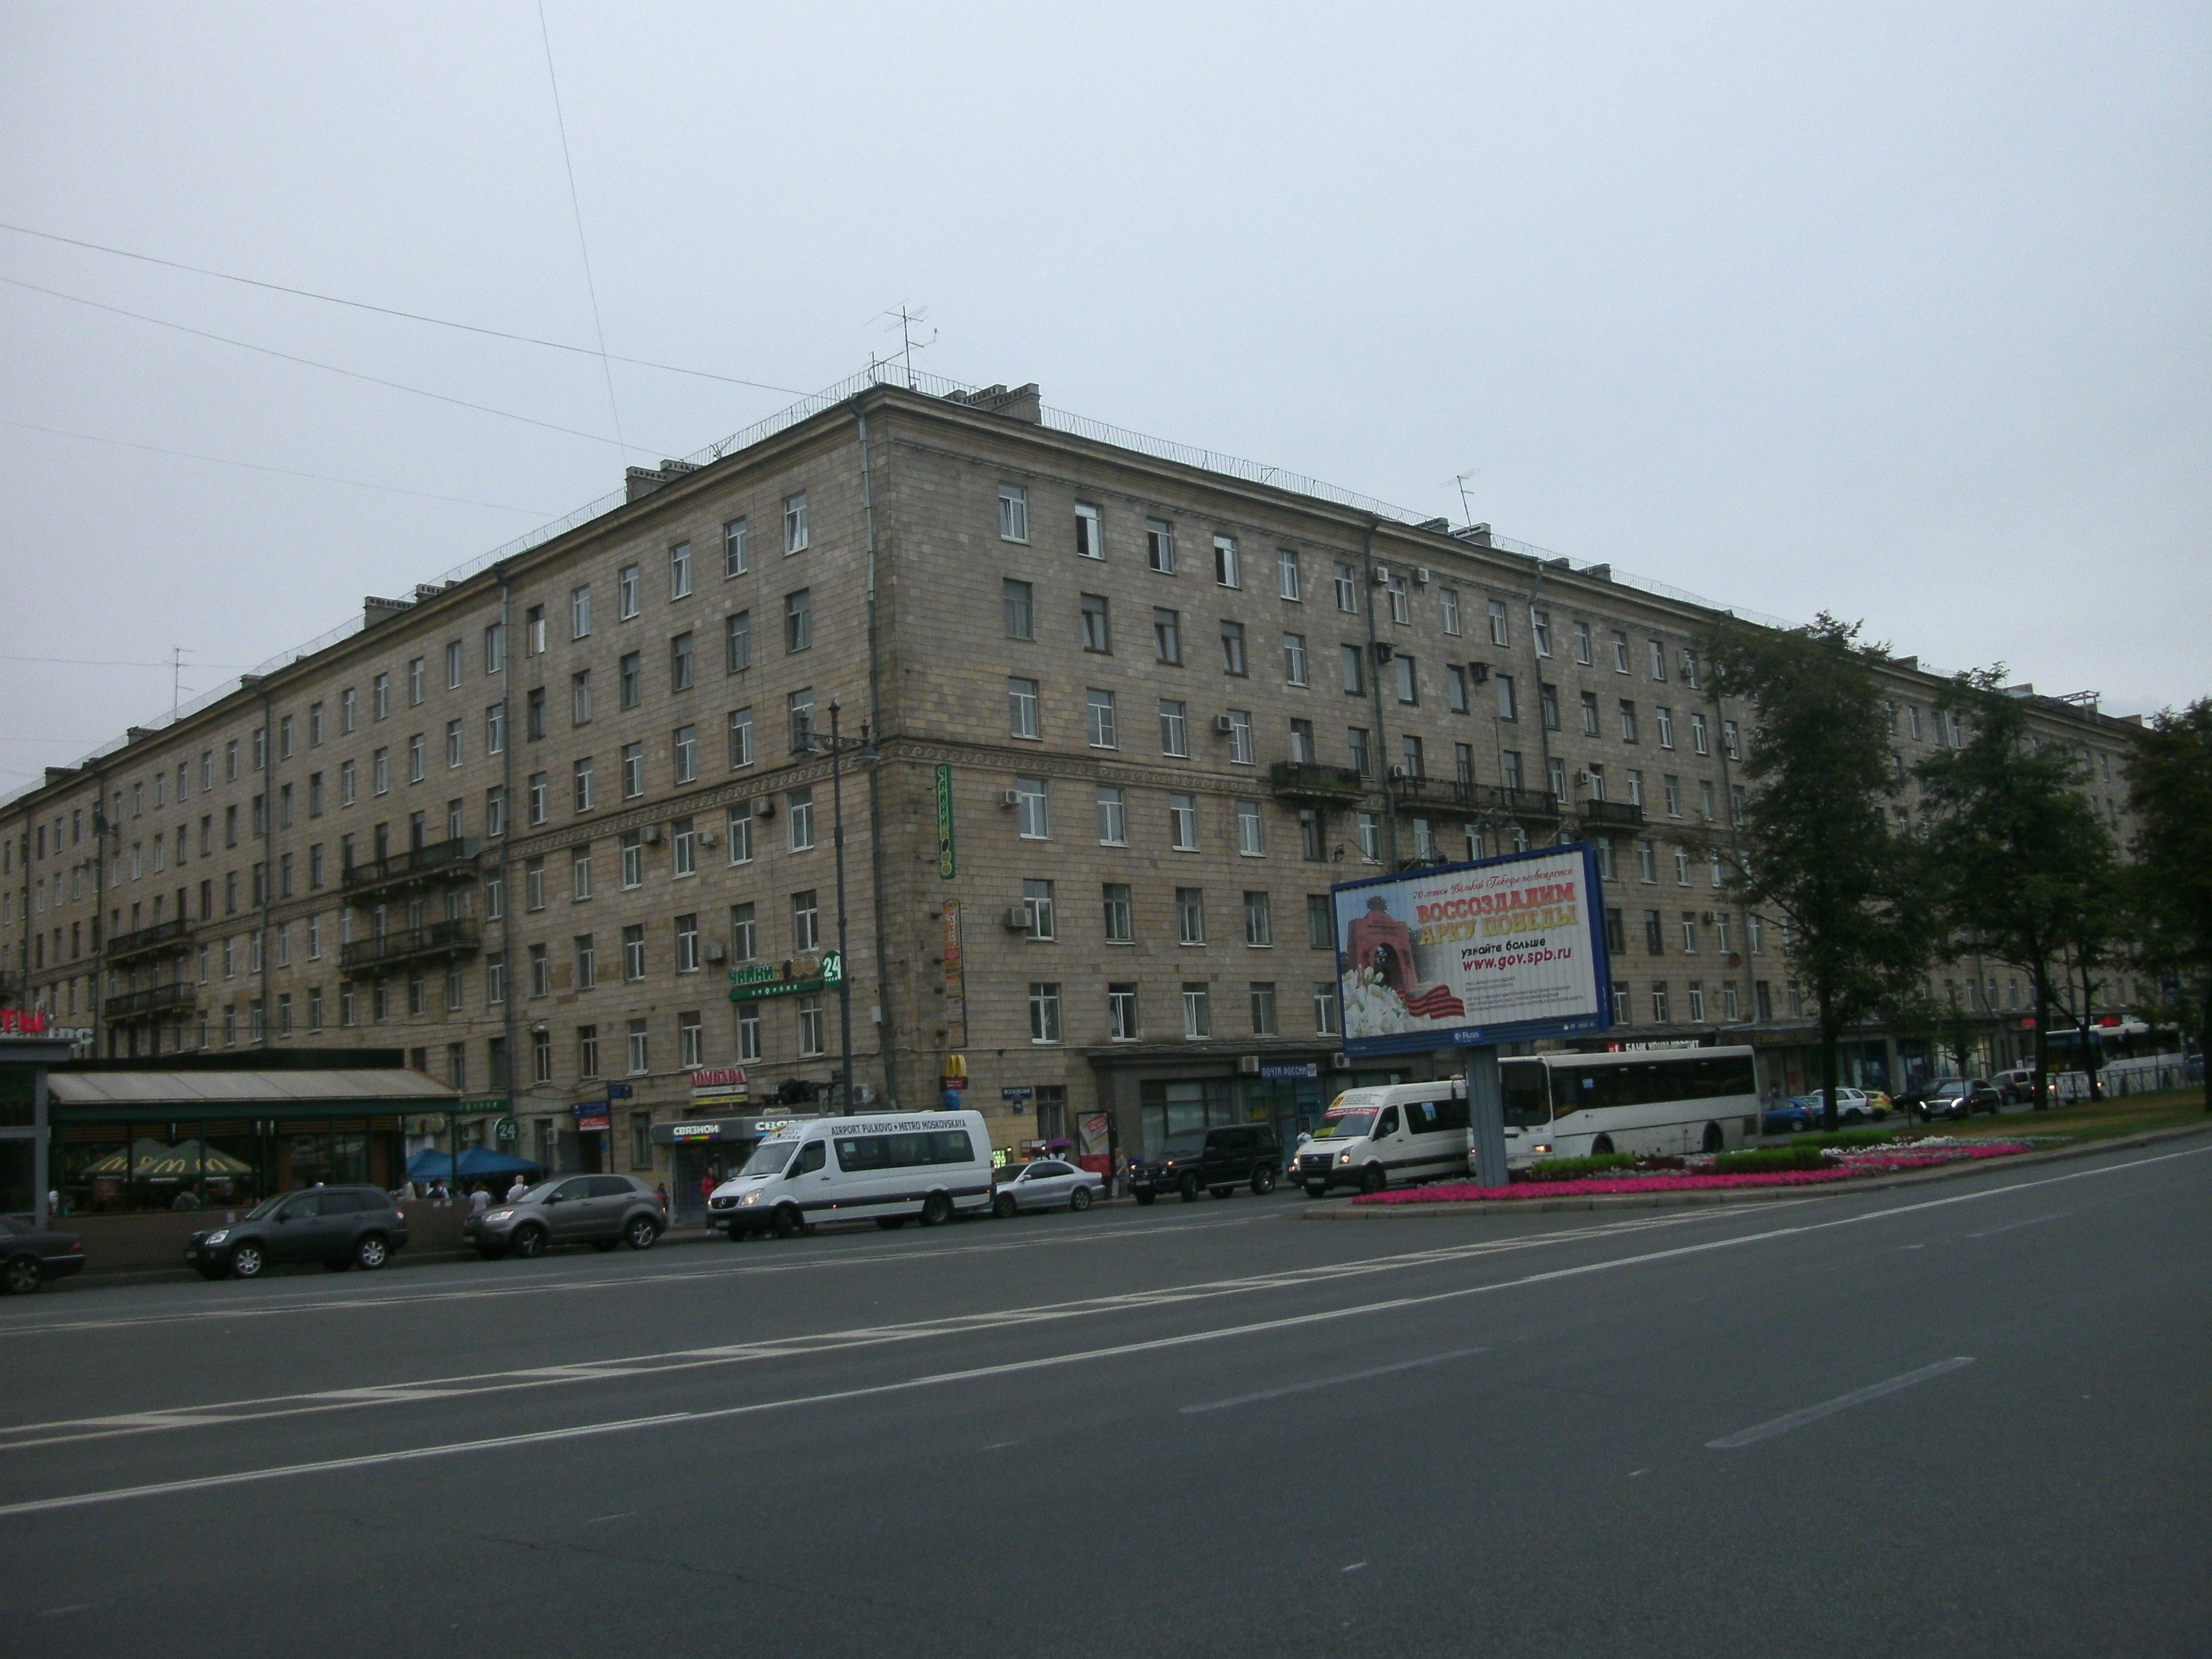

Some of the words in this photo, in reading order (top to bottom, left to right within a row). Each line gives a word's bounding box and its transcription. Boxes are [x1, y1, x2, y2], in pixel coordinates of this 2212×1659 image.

[1486, 874, 1520, 888] Победы
[1416, 882, 1576, 924] ВОССОЗДАДИМ
[1419, 919, 1476, 946] АРКУ
[1481, 904, 1578, 937] ПОБЕДЫ
[1461, 943, 1503, 959] узнайте
[1505, 938, 1546, 951] больше
[823, 955, 842, 980] 24
[1463, 947, 1572, 971] www.gov.spb.ru
[1262, 1067, 1282, 1077] ПОЧТА
[1284, 1065, 1308, 1076] РОССИИ
[500, 1124, 516, 1140] 24
[673, 1122, 720, 1136] СВЯЗНОЙ
[831, 1124, 860, 1136] AIRPORT
[862, 1122, 893, 1134] PULKOVO
[899, 1120, 921, 1131] METRO
[922, 1118, 967, 1130] MOSKOVSKAYA
